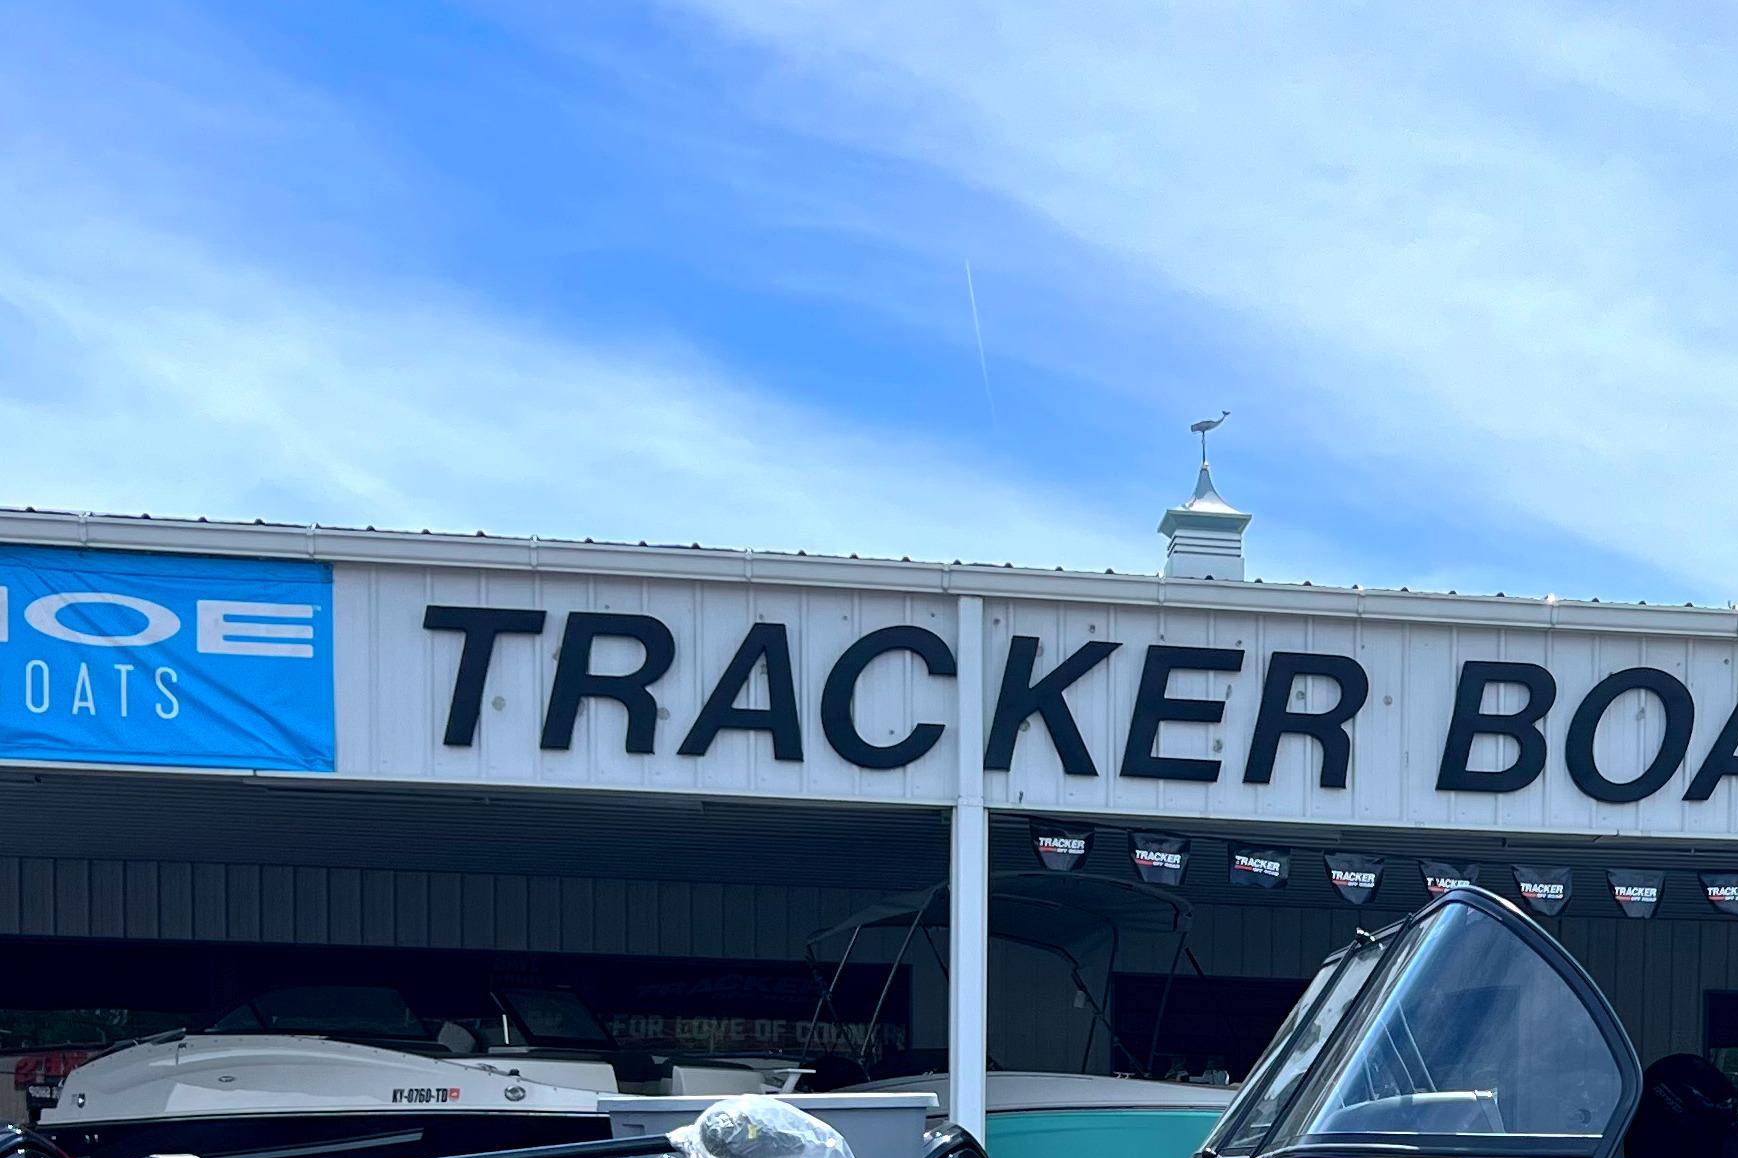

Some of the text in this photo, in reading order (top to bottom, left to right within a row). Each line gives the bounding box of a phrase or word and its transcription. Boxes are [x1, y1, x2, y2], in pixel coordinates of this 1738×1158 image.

[0, 586, 314, 658] OE
[423, 604, 1369, 789] TRACKER
[1038, 836, 1085, 850] TRACKER
[1135, 849, 1181, 863] TRACKER
[1331, 870, 1376, 883] TRACKER
[1520, 882, 1563, 894] TRACKER
[1614, 886, 1657, 897] TRACKER
[611, 1013, 663, 1039] FOR
[675, 1015, 746, 1042] LOVE
[753, 1019, 787, 1042] OF
